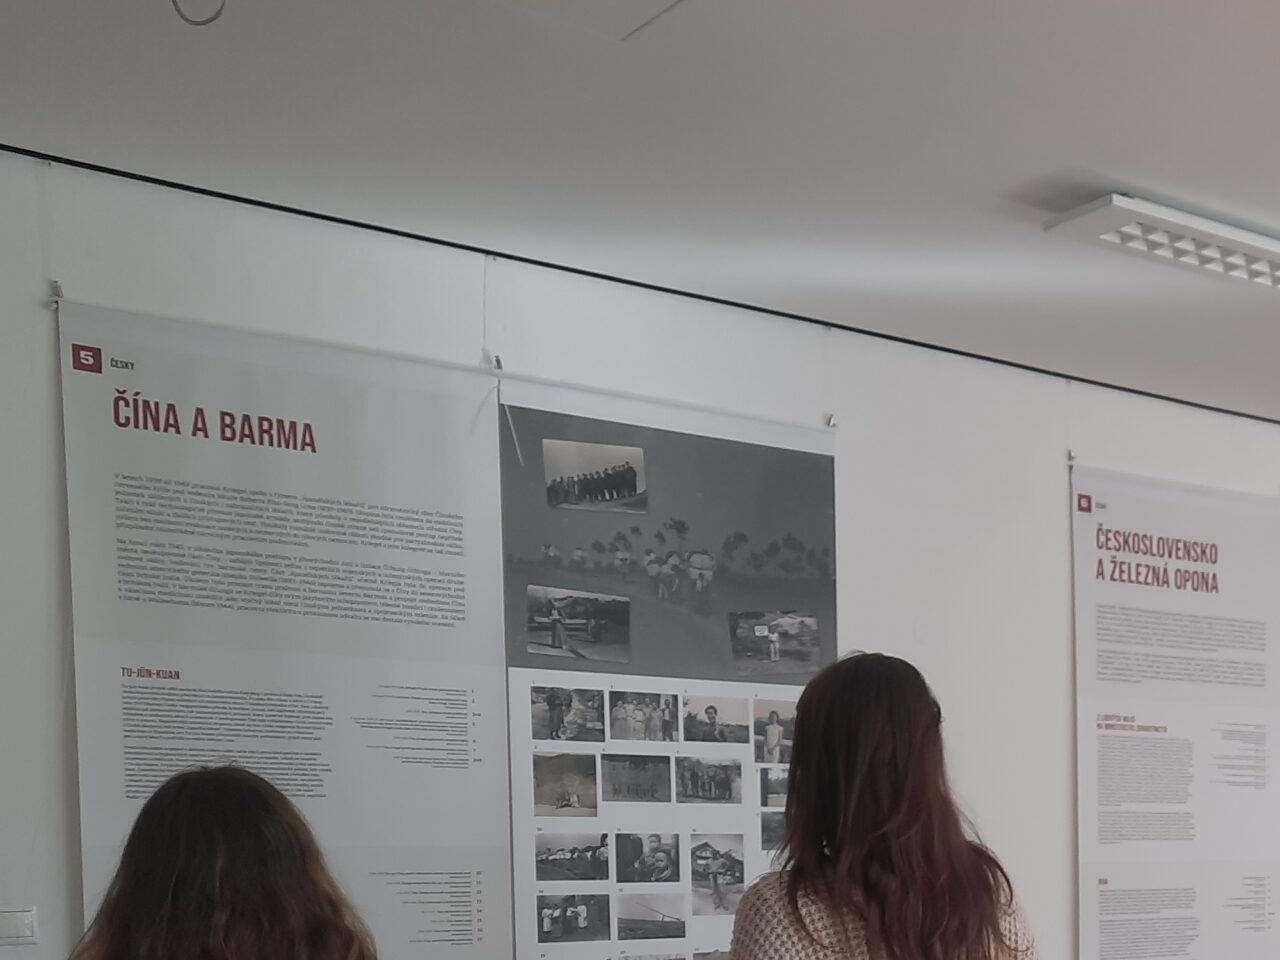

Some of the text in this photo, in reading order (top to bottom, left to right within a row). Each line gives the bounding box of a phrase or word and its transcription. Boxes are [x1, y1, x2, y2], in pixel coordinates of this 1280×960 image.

[79, 350, 95, 366] 5
[112, 388, 317, 454] ČÍNA A BARMA
[1095, 523, 1219, 565] ČESKOSLOVENSKO
[1095, 555, 1220, 594] A ŽELEZNÁ OPONA
